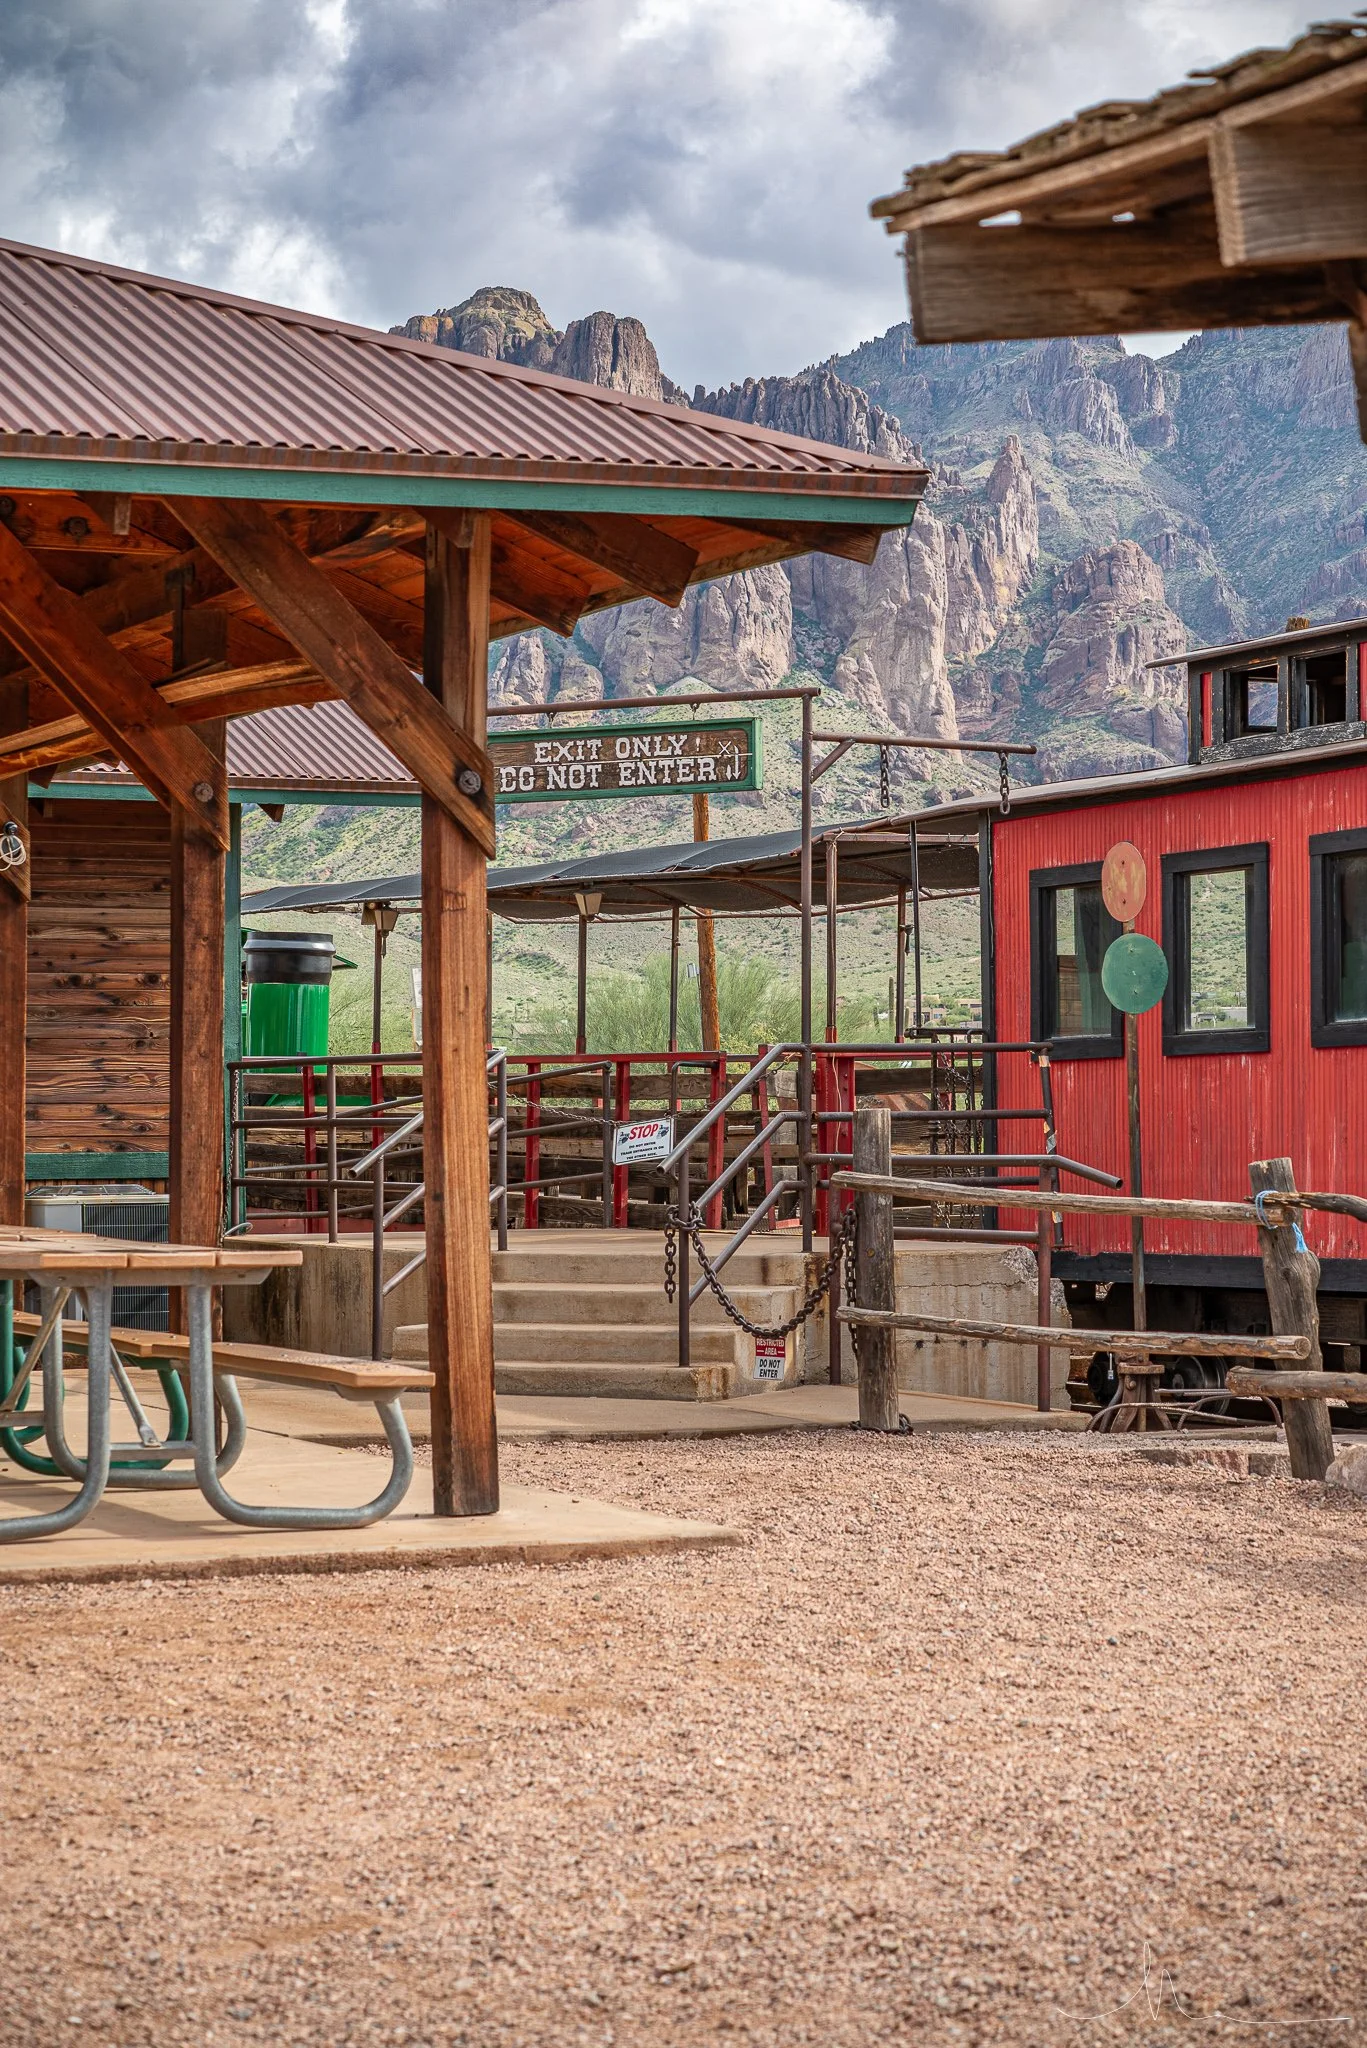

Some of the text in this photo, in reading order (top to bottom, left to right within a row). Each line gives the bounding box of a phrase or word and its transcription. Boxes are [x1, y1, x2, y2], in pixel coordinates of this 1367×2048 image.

[534, 740, 602, 763] EXIT
[500, 758, 717, 792] DO NOT ENTER
[629, 1123, 659, 1140] STOP
[759, 1359, 780, 1368] DO NOT
[759, 1369, 778, 1378] ENTER
